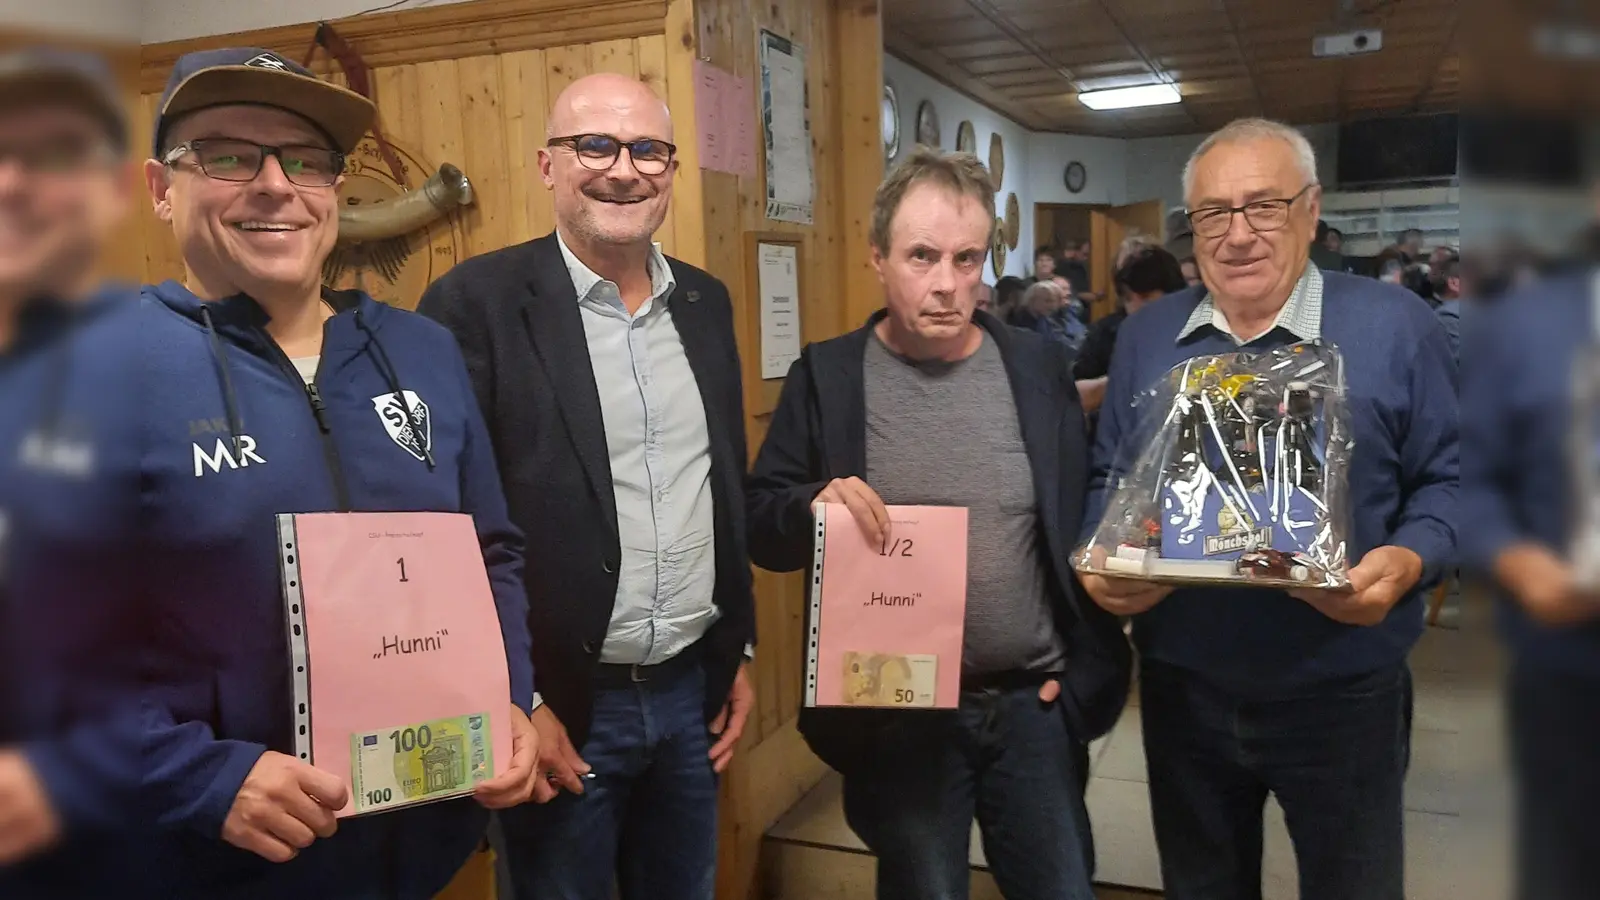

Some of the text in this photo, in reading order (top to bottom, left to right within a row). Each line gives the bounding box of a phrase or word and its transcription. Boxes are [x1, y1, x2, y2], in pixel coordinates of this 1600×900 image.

[192, 434, 267, 477] MR
[879, 538, 914, 557] 1/2
[396, 557, 409, 582] 1
[895, 688, 914, 703] 50
[389, 725, 432, 754] 100
[366, 787, 392, 805] 100
